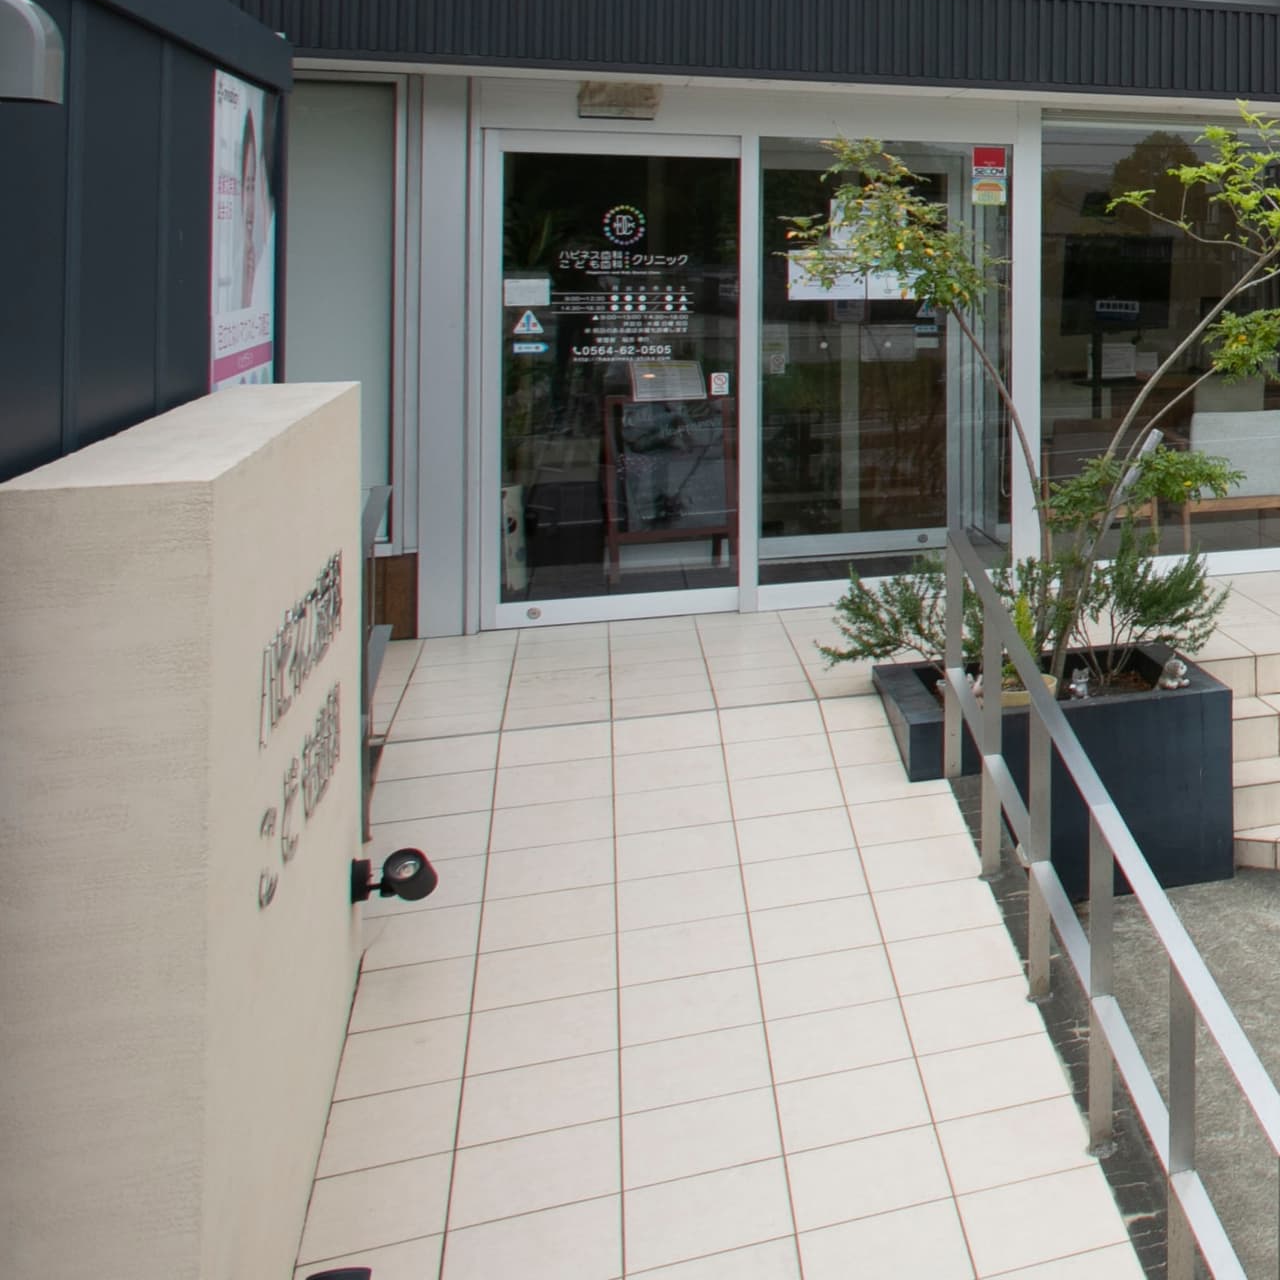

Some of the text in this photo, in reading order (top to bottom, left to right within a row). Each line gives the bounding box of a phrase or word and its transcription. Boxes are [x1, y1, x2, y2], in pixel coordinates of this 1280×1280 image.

[974, 167, 1005, 176] SECOM
[559, 250, 623, 260] ハピネス歯科
[632, 254, 688, 266] クリニック
[582, 345, 673, 356] 0564-62-0505
